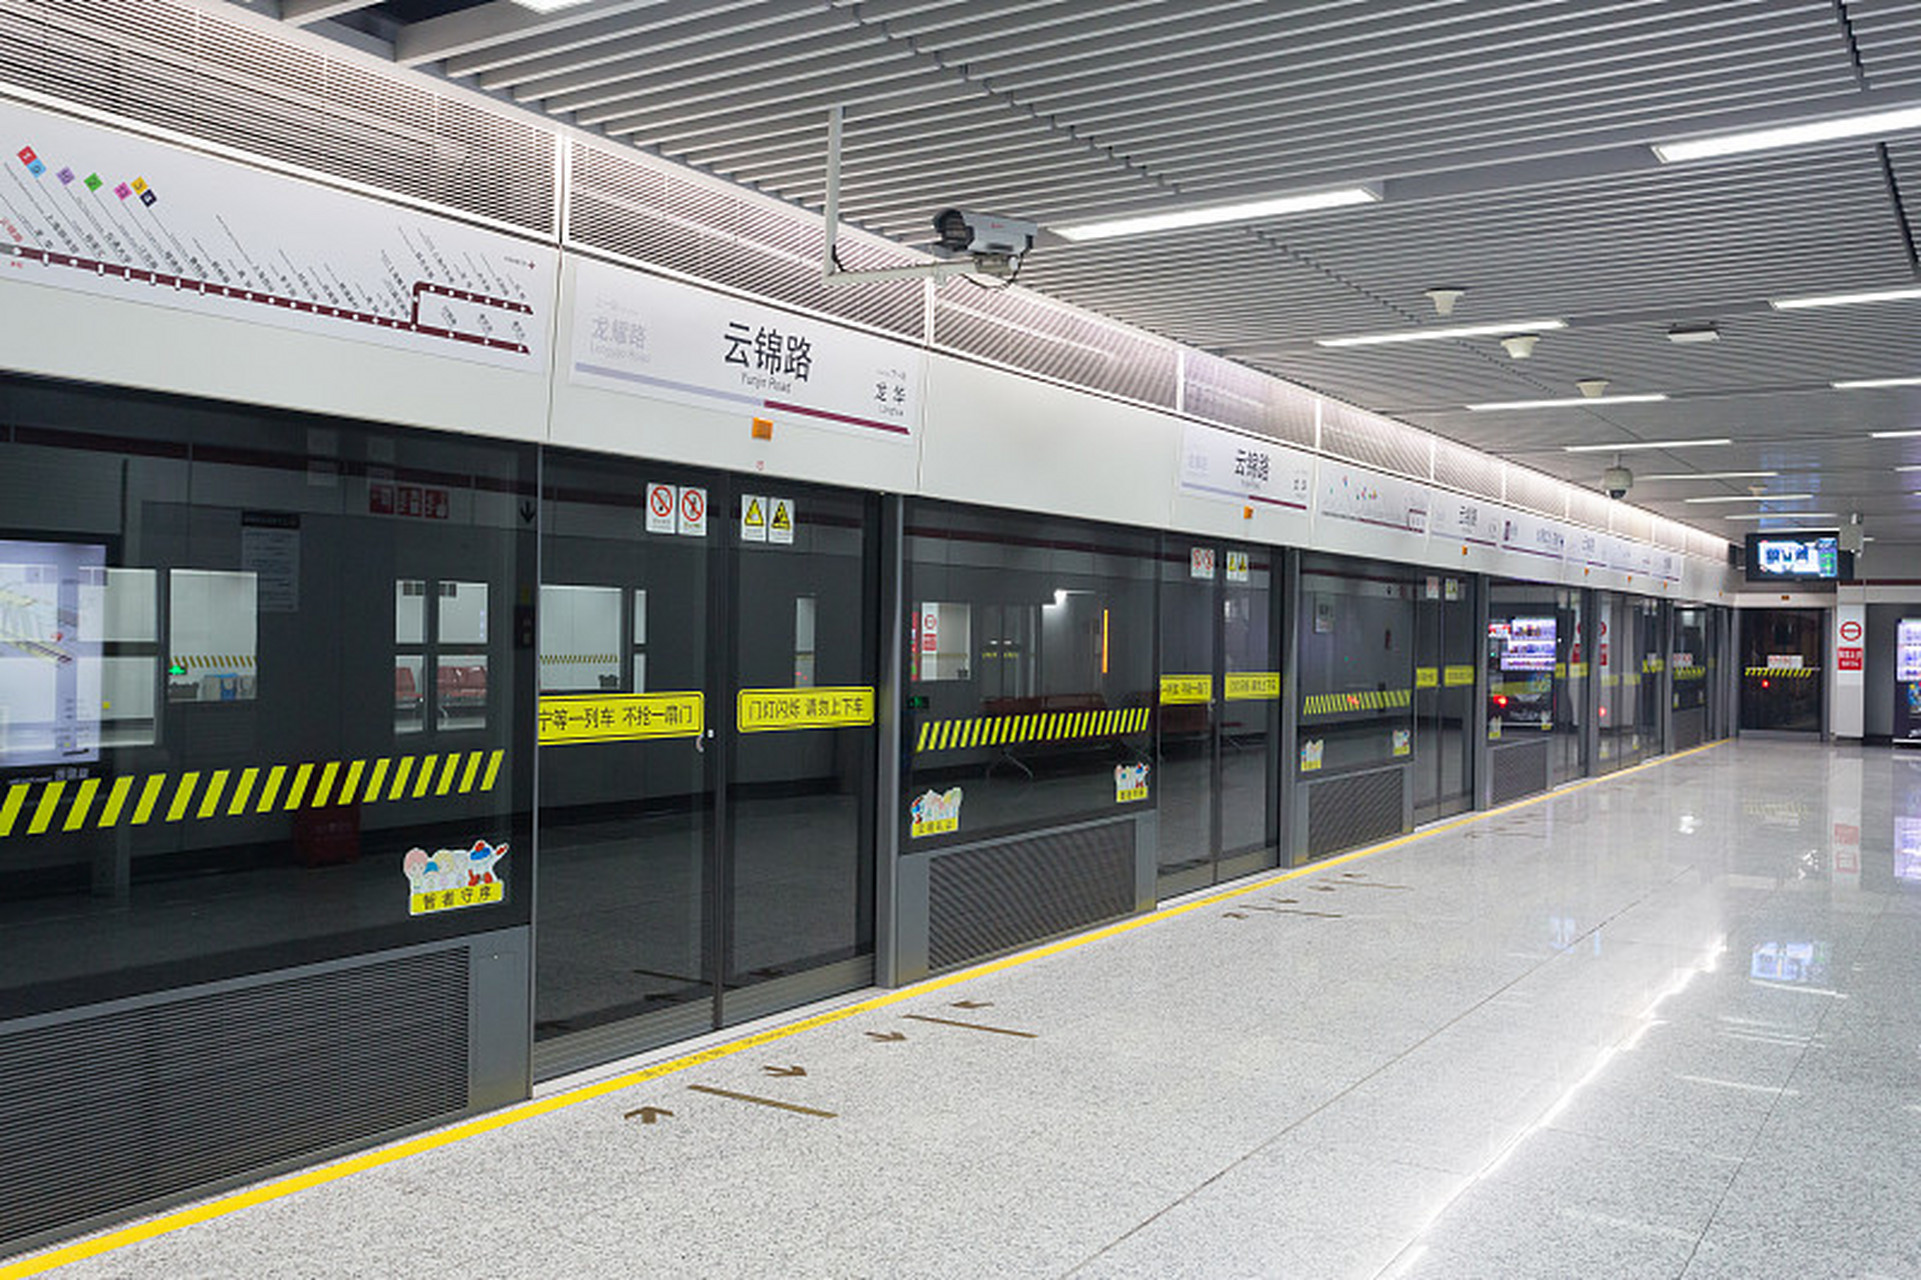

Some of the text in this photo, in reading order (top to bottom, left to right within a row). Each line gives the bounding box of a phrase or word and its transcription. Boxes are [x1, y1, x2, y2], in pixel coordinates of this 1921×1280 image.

[724, 321, 813, 383] 云锦路
[768, 376, 792, 394] Road
[1234, 449, 1269, 481] 云锦路
[804, 697, 864, 717] 请勿上下车
